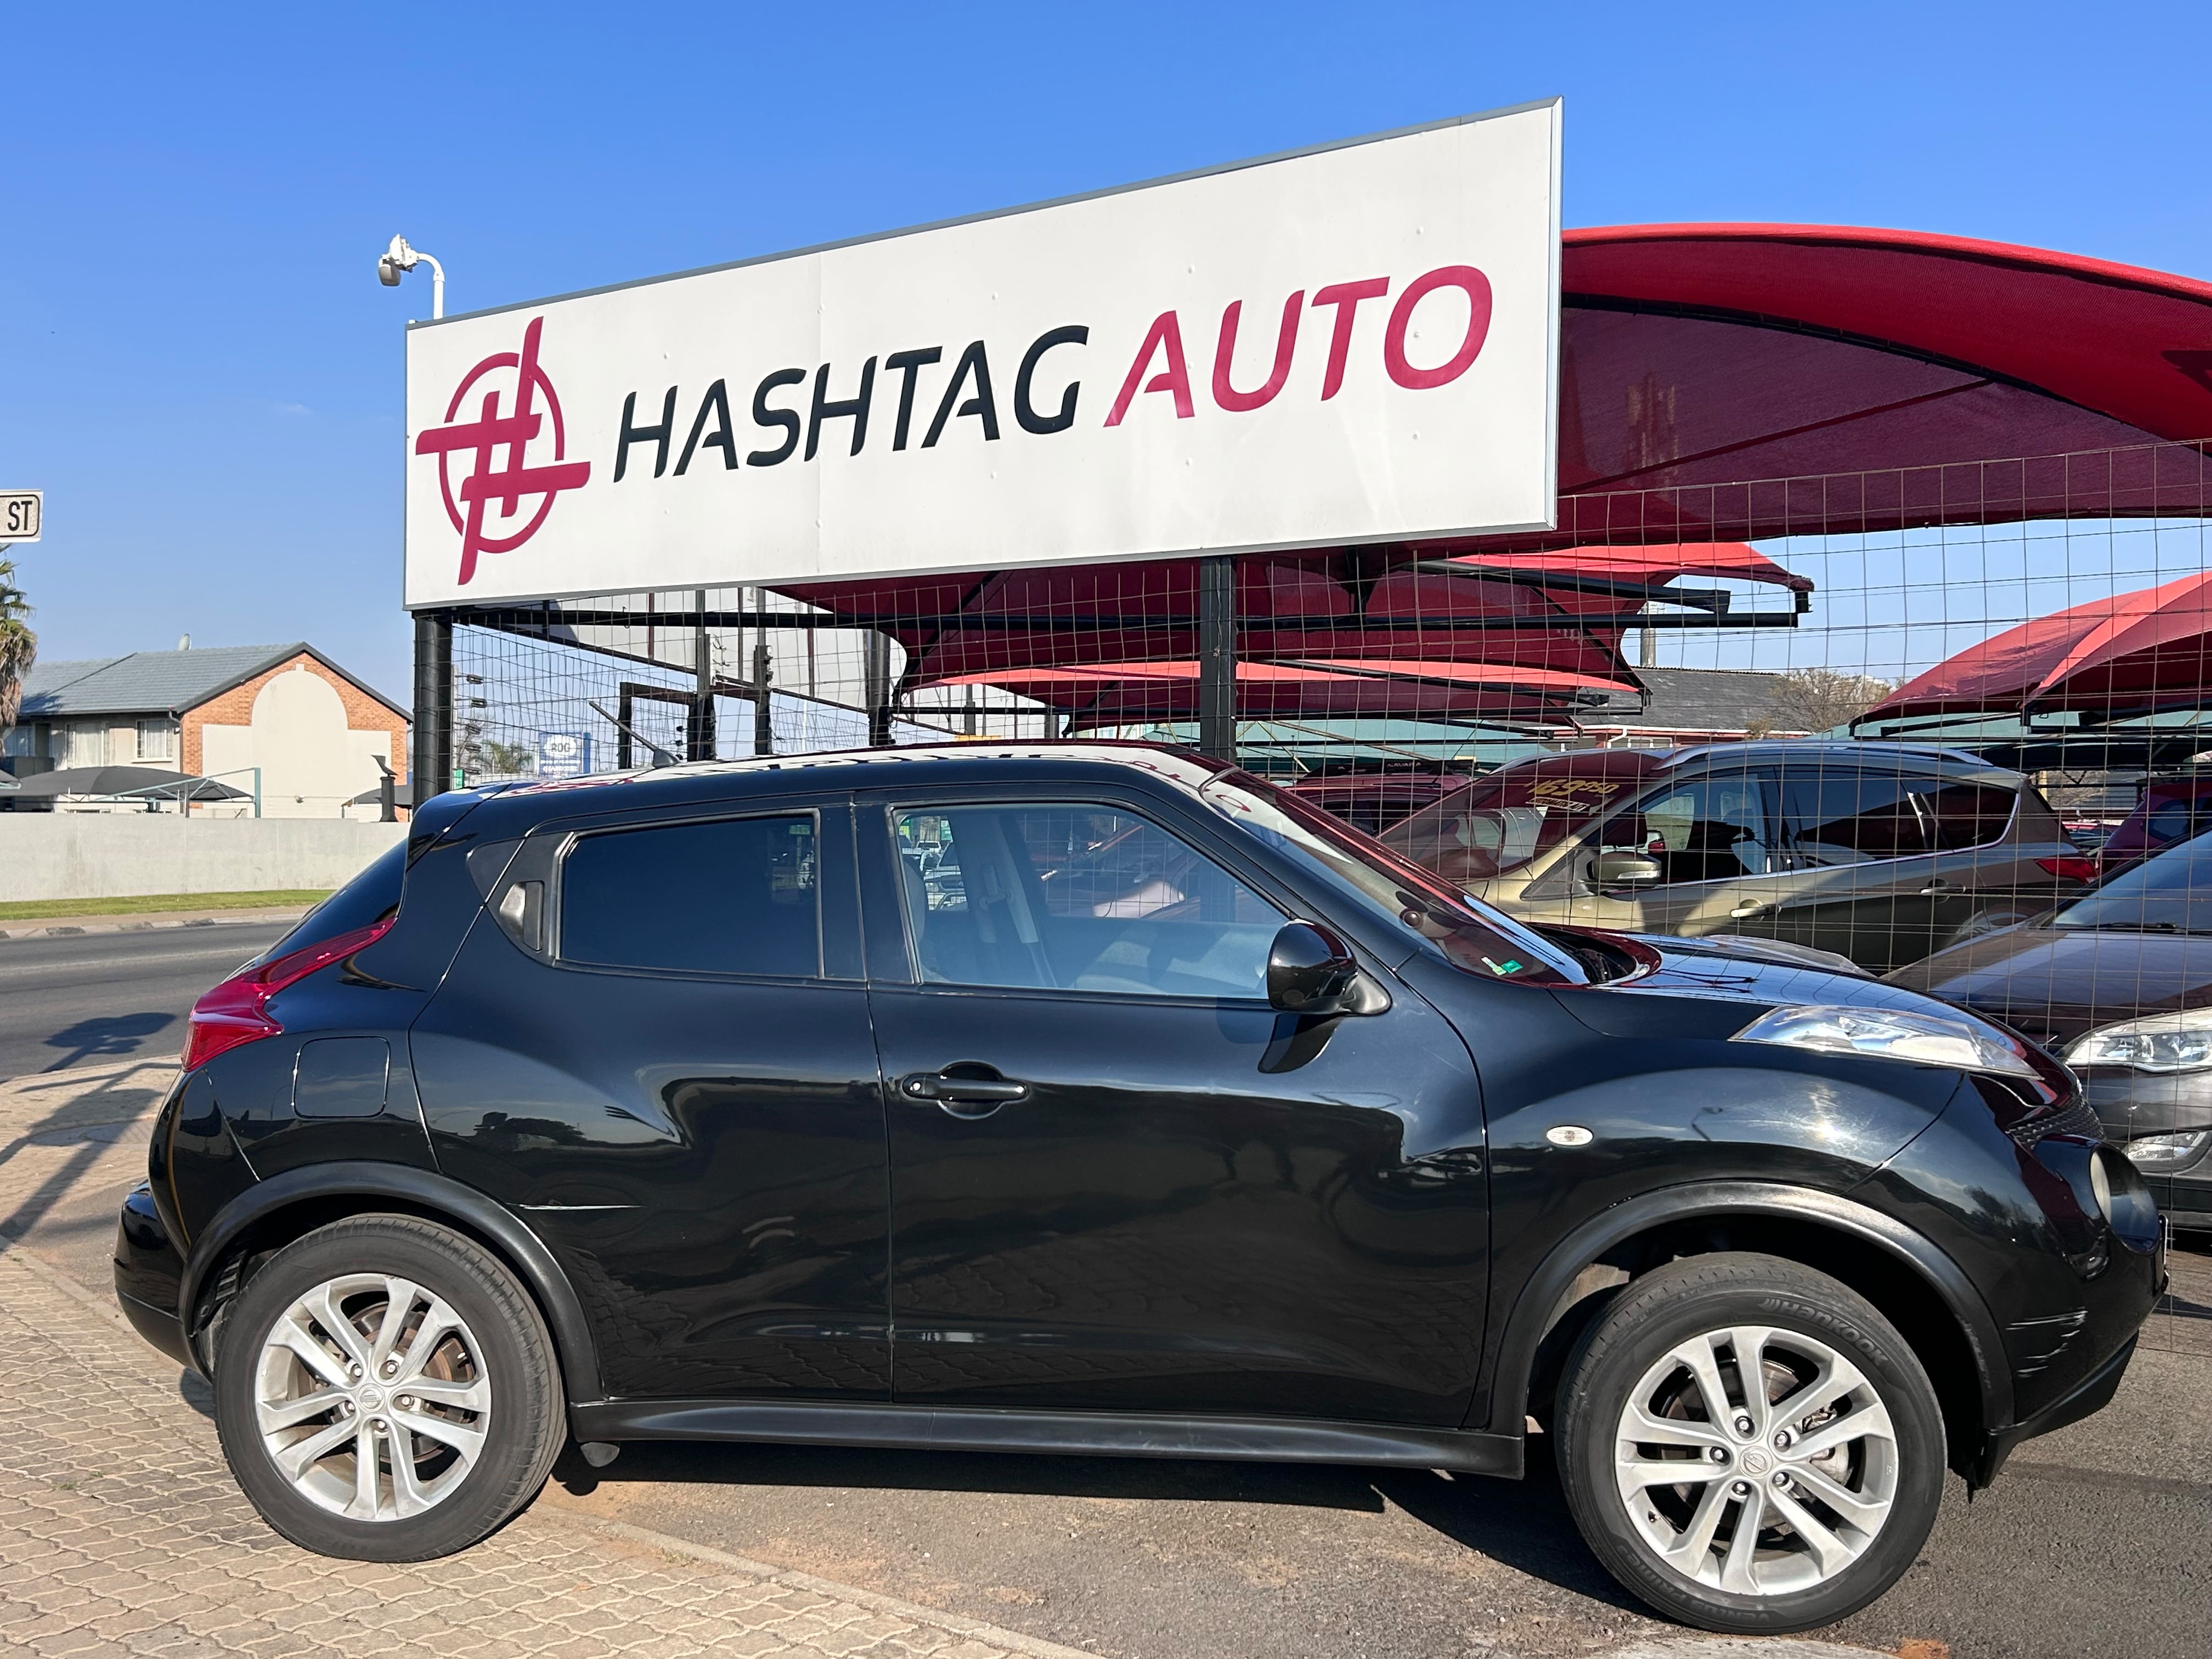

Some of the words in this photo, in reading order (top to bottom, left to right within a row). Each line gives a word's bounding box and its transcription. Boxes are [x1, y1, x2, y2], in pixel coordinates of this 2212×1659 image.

[613, 324, 1090, 483] HASHTAG
[1102, 264, 1493, 428] AUTO
[7, 500, 33, 532] ST
